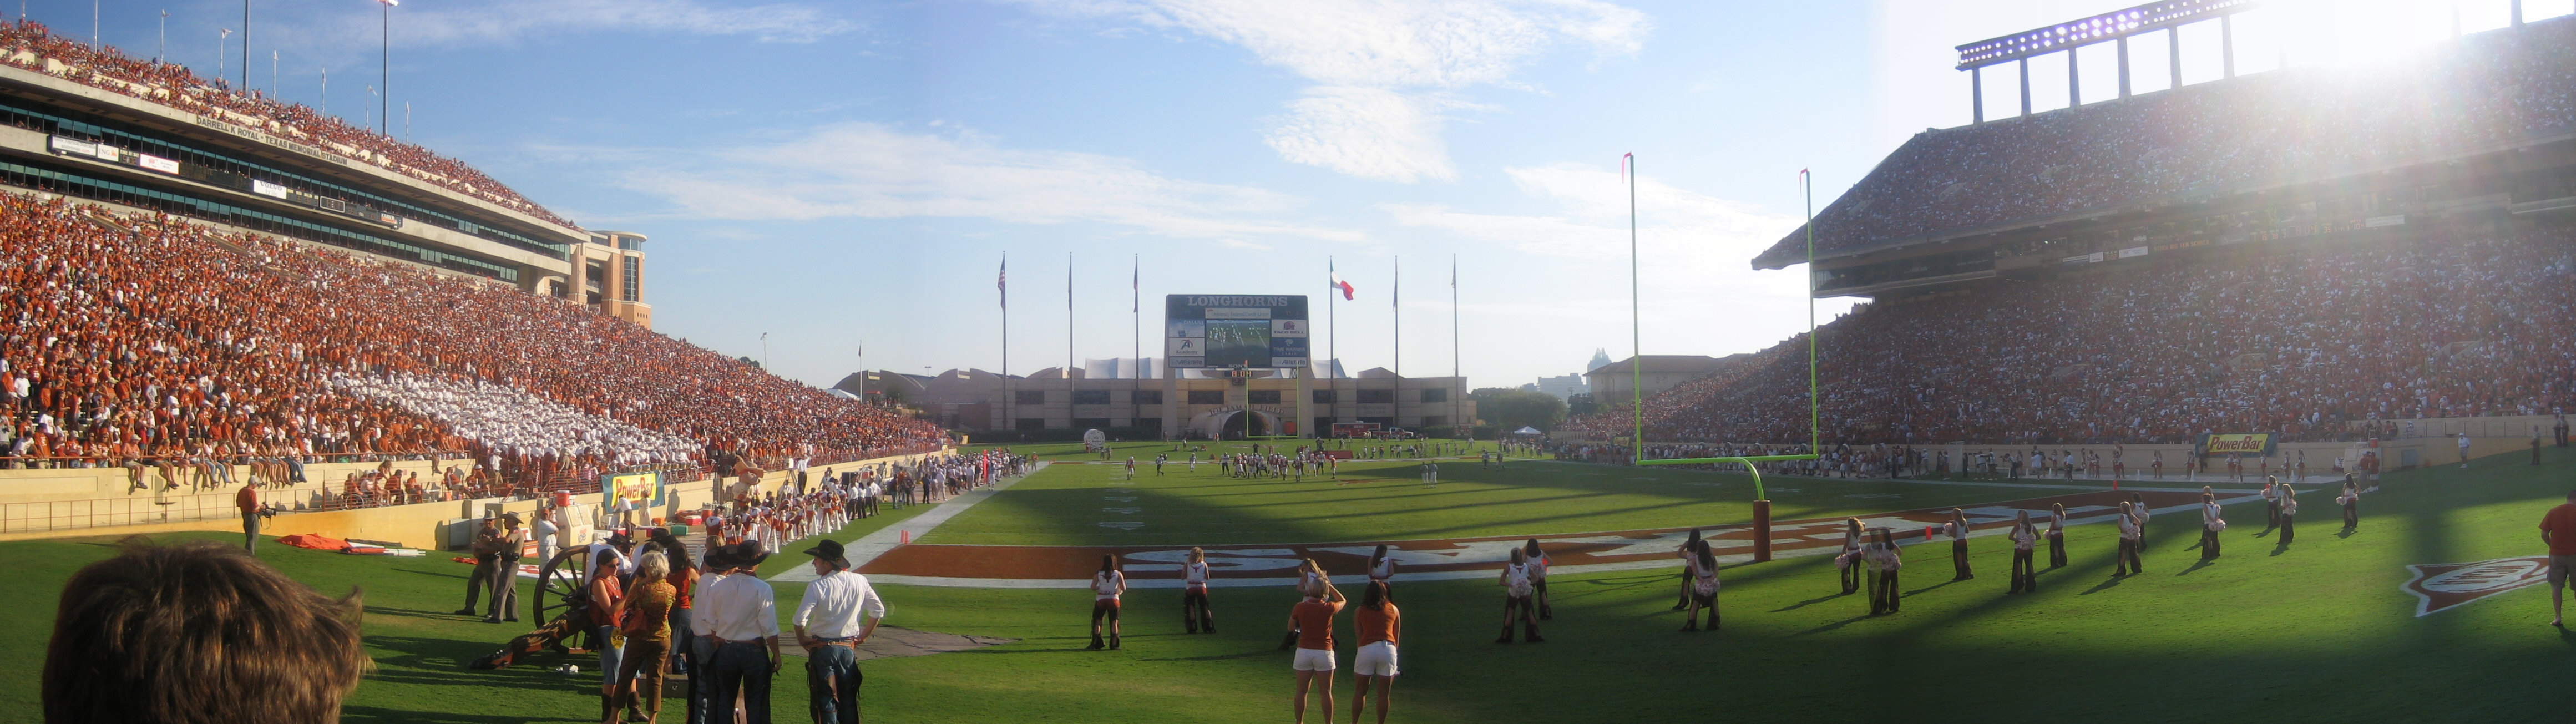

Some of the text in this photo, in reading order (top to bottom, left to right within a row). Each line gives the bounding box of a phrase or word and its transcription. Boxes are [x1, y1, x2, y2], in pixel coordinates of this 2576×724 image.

[197, 117, 229, 132] DARRELL
[238, 128, 259, 140] ROYAL
[265, 136, 287, 148] TEXAS
[289, 143, 321, 157] MEMORIAL
[322, 150, 347, 165] STADIUM
[260, 180, 282, 191] VOLVO
[1187, 296, 1288, 306] LONGHORNS
[2210, 436, 2263, 450] PowerBar
[616, 477, 654, 501] PowerBar
